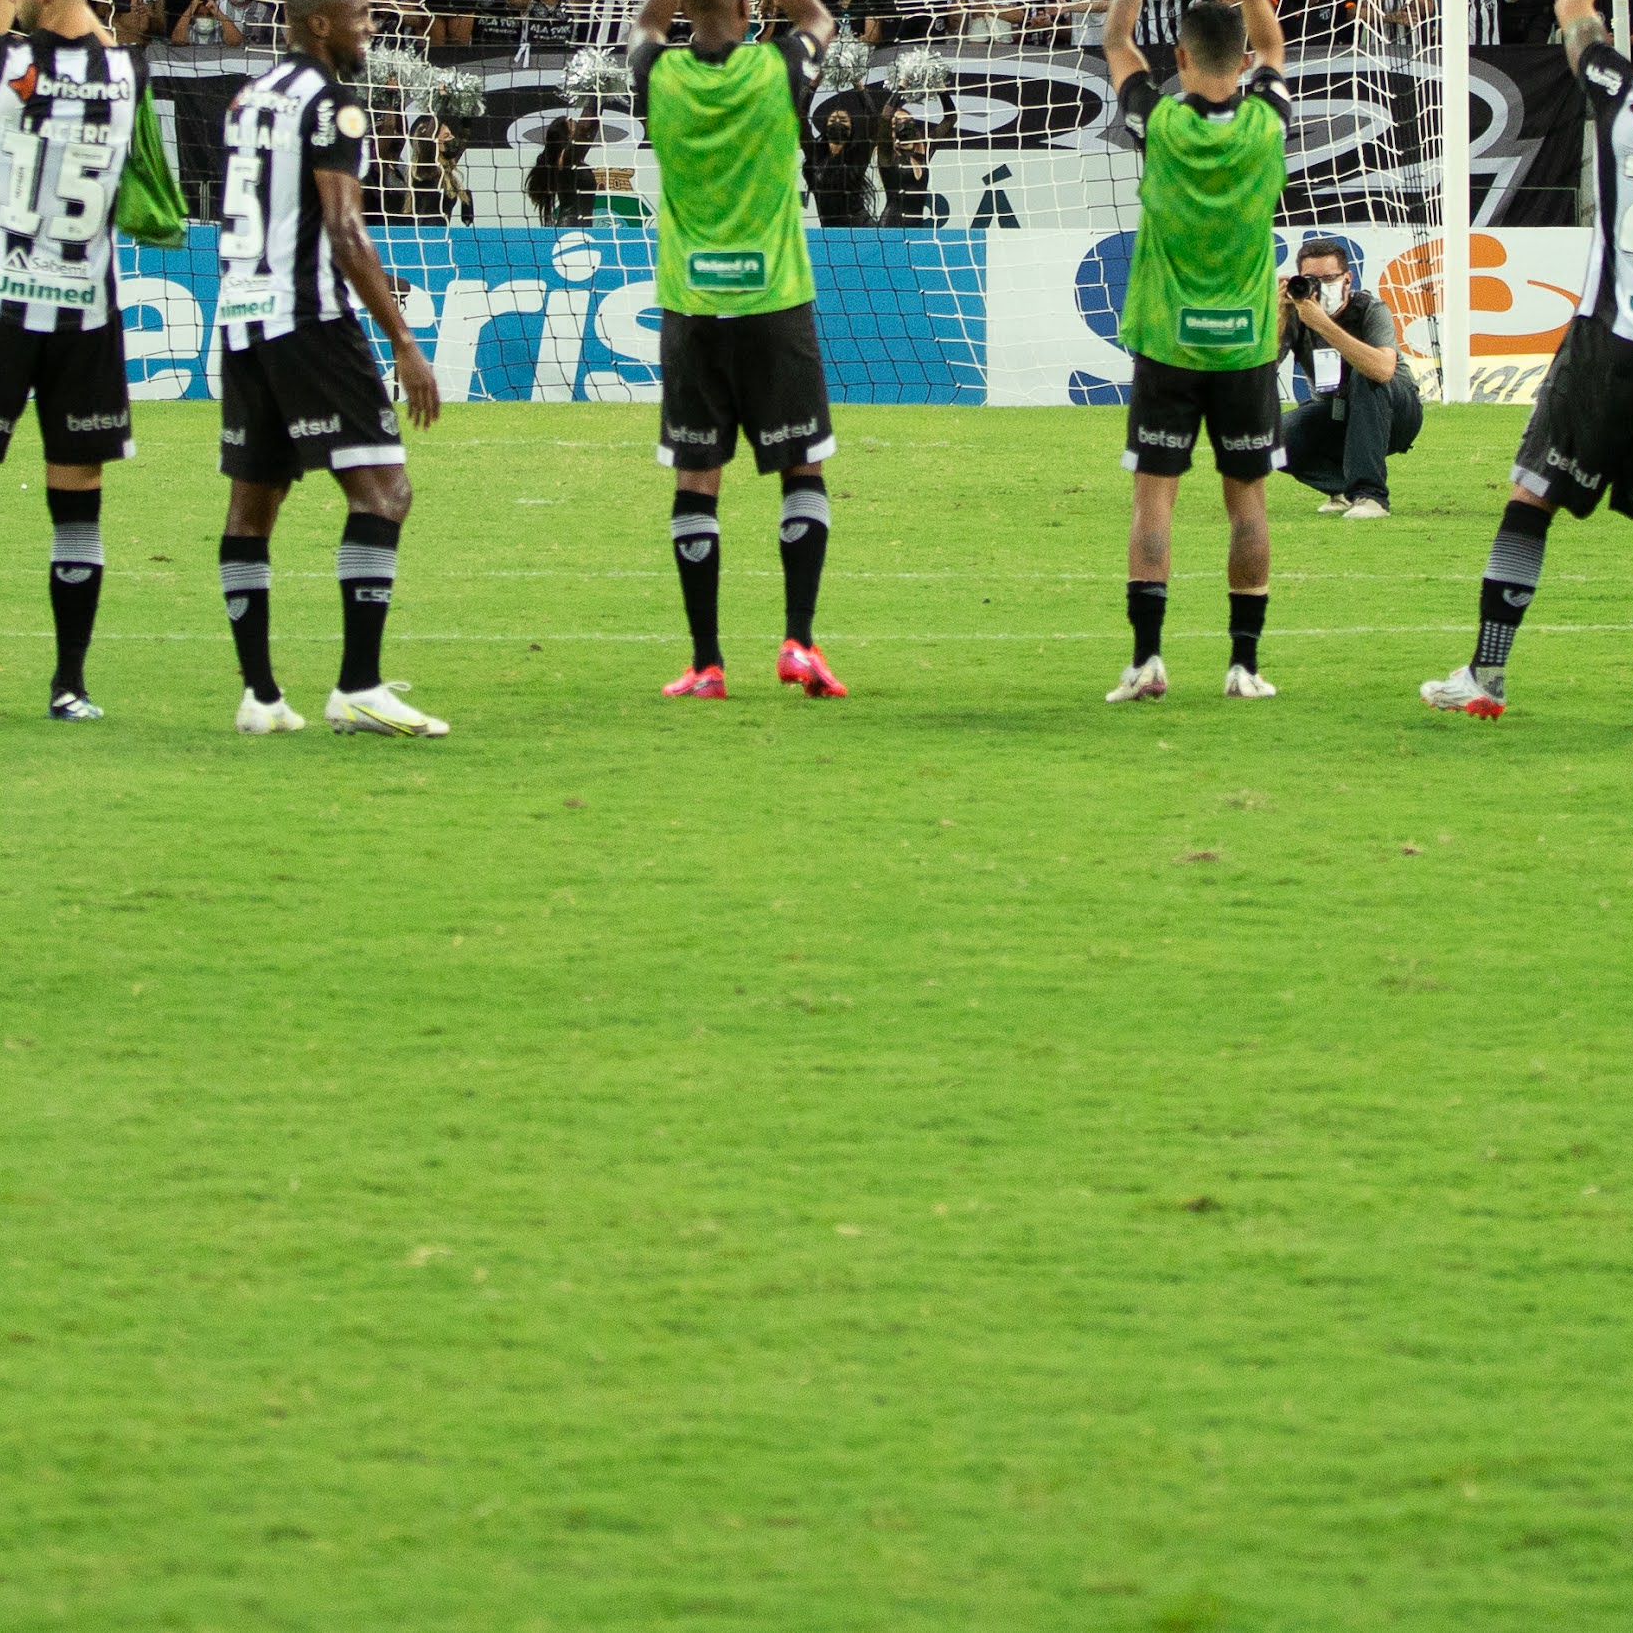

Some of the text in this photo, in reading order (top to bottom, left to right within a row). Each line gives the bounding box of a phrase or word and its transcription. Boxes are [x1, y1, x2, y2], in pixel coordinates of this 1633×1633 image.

[36, 73, 131, 103] brisanet
[0, 130, 115, 245] 15
[218, 154, 265, 260] 5
[219, 295, 276, 319] imed
[66, 411, 129, 434] betsul
[288, 413, 342, 440] etsul
[760, 418, 818, 447] betsul
[1137, 424, 1276, 452] betsul betsul
